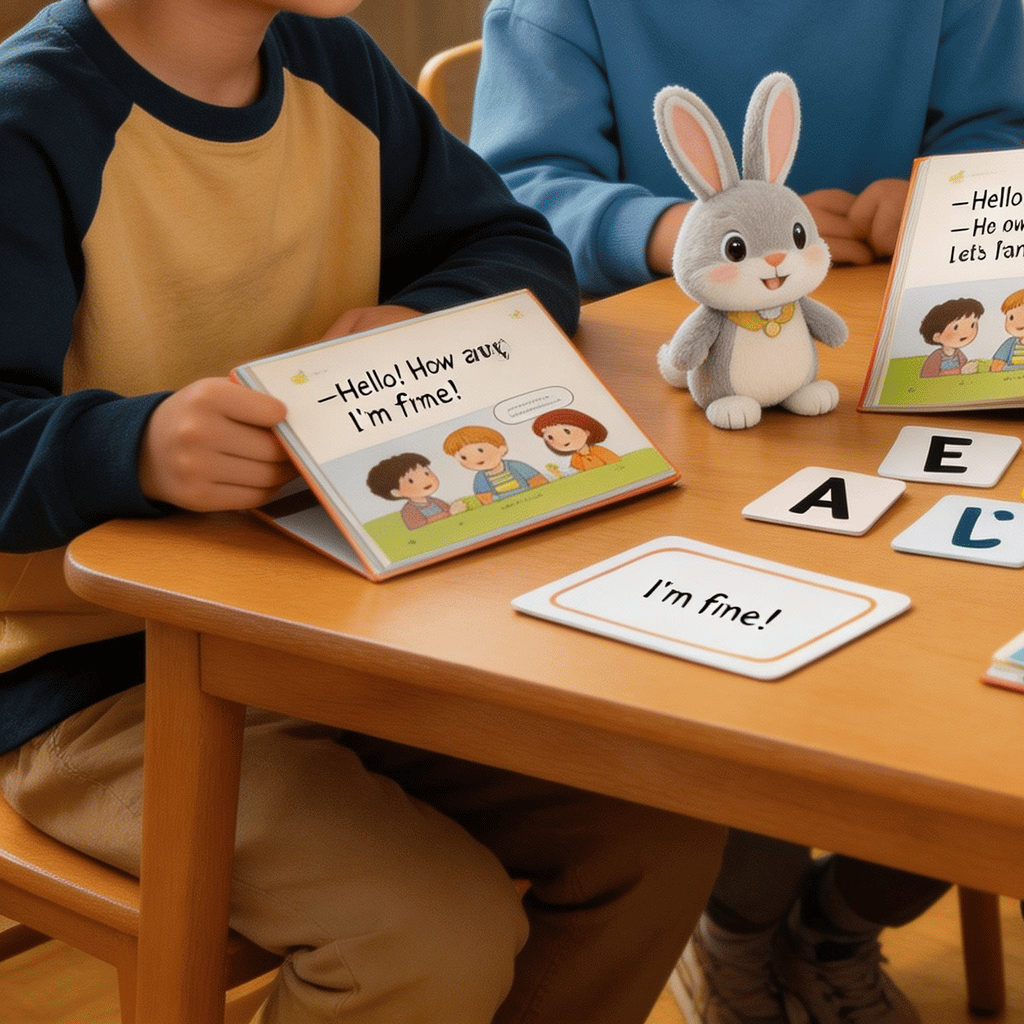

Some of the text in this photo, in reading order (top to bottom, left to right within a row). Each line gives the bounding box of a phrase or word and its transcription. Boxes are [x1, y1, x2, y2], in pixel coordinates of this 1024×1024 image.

[405, 353, 454, 381] How
[348, 407, 393, 433] I'm
[923, 434, 973, 473] E
[788, 476, 849, 520] A
[643, 579, 693, 608] I'm
